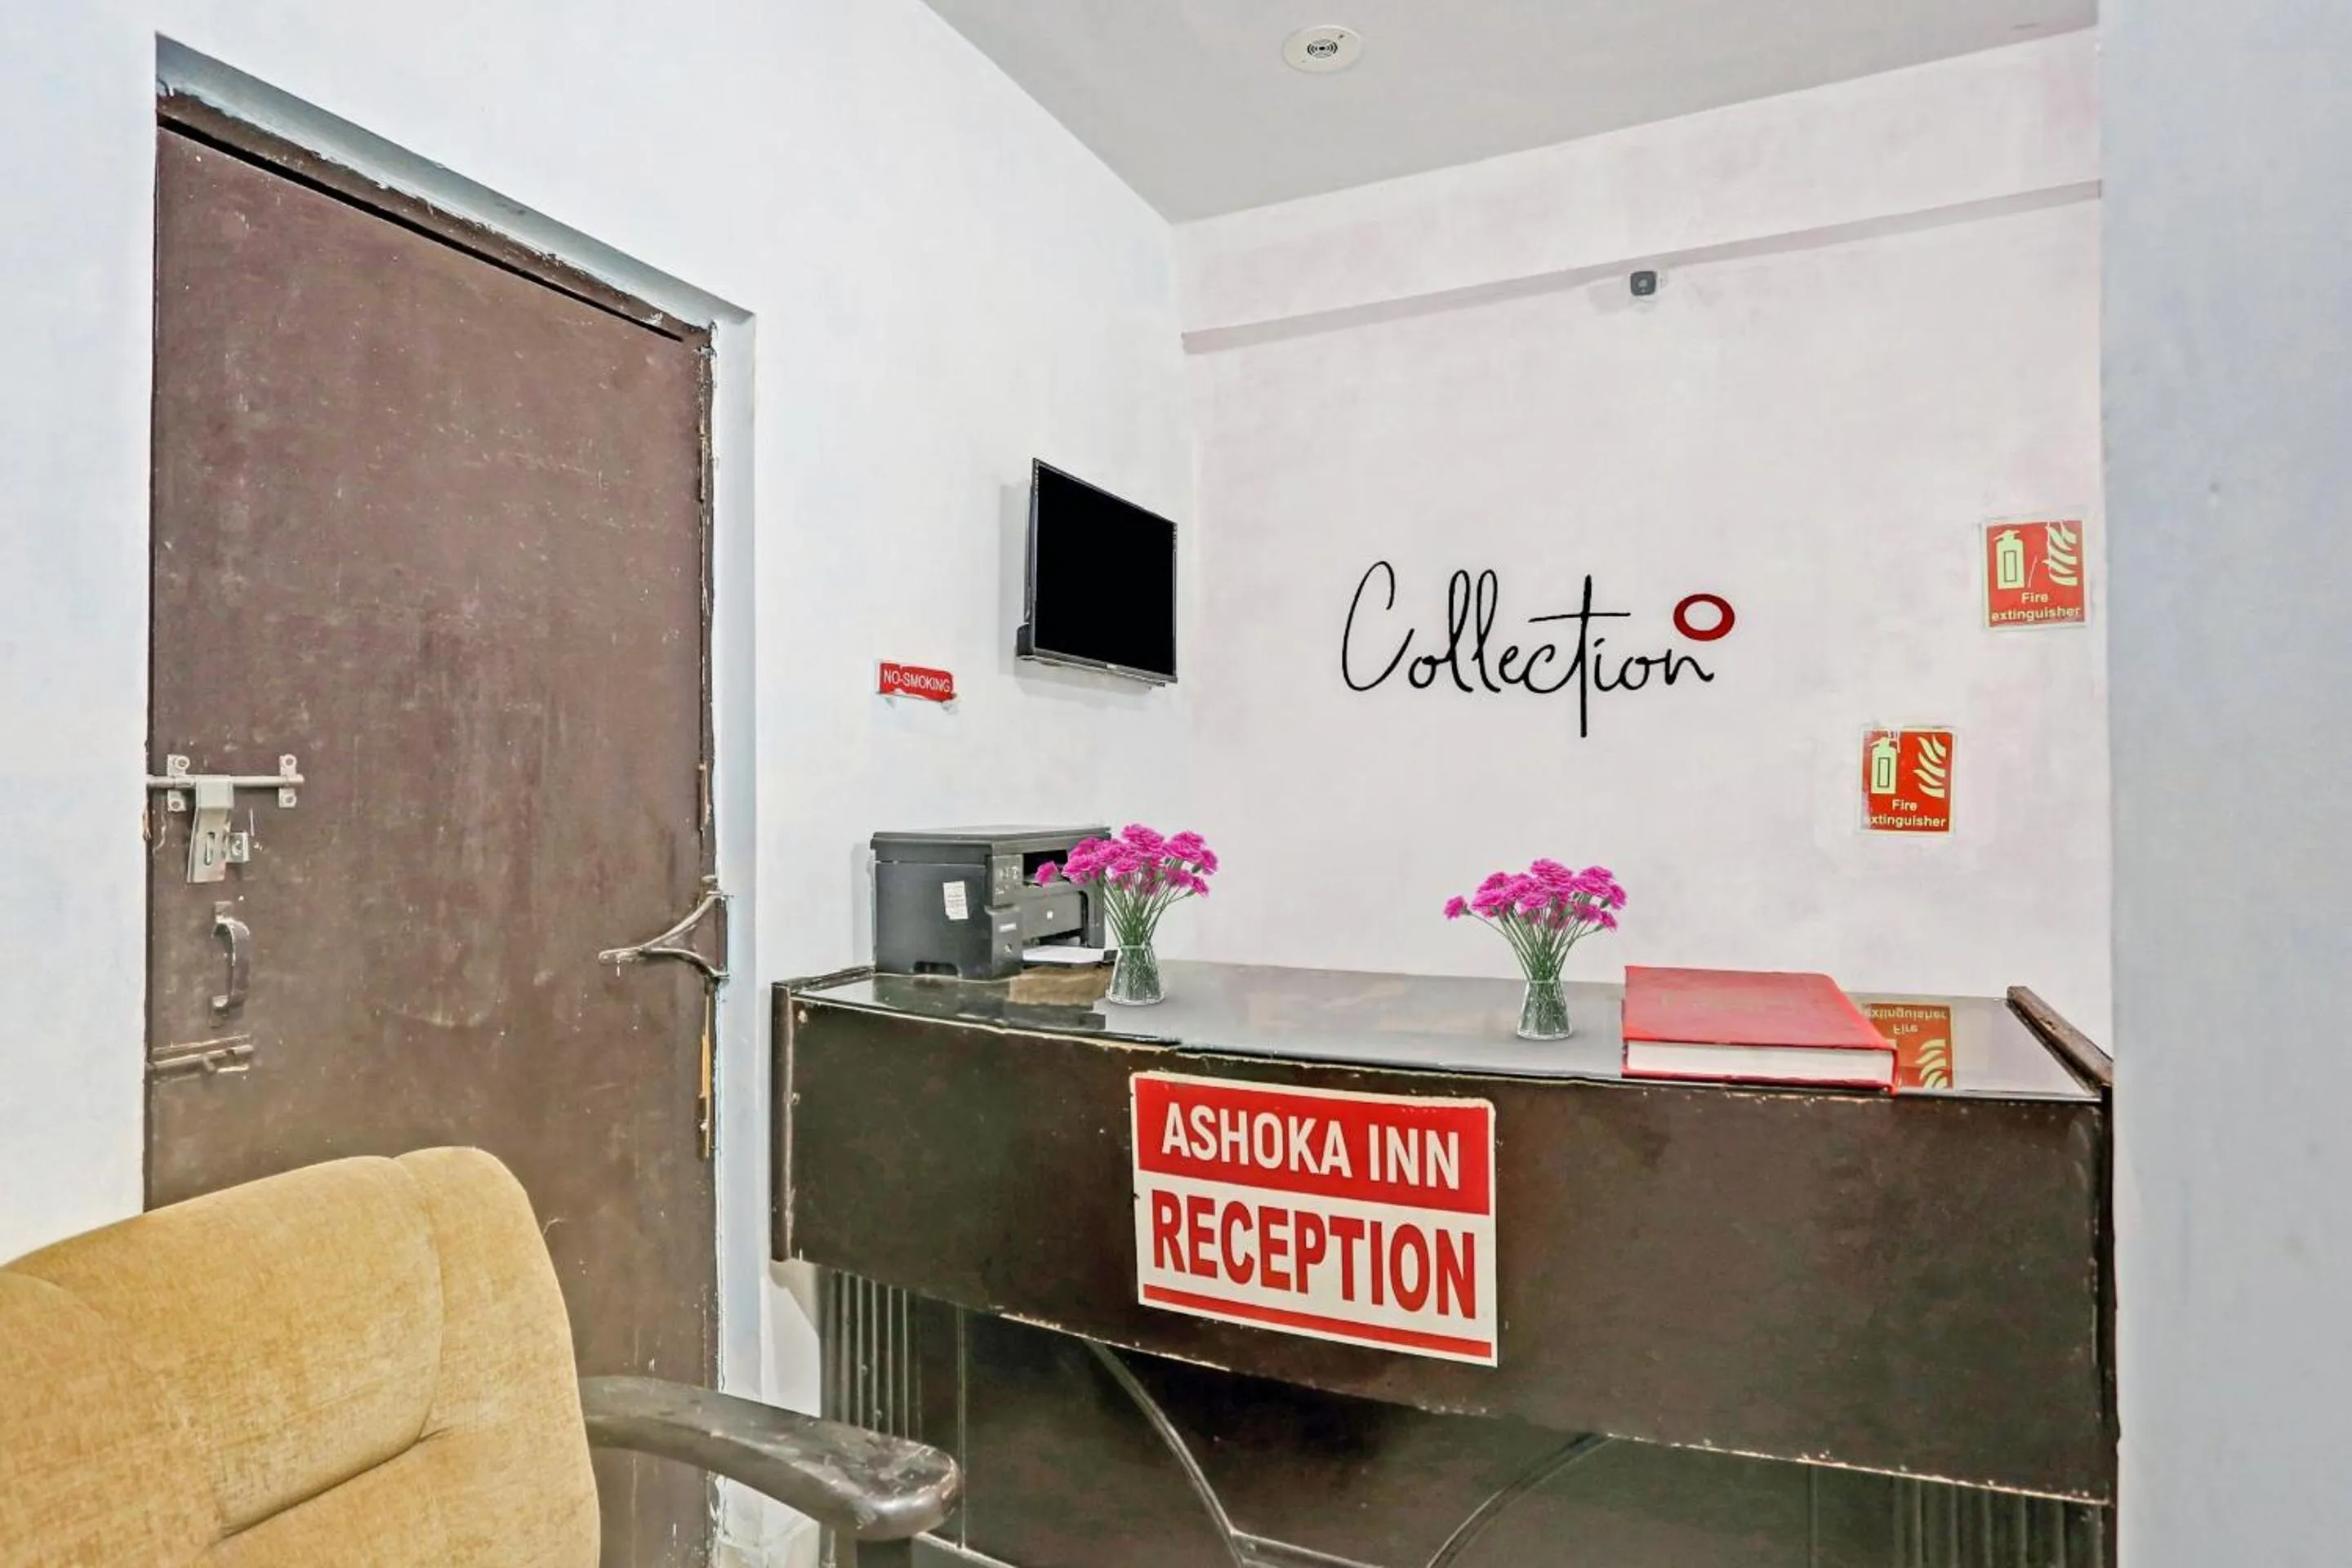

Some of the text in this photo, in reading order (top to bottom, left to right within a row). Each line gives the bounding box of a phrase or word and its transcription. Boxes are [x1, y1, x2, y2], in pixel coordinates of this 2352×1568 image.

[2021, 592, 2048, 604] Fire
[1991, 605, 2081, 621] extinguisher
[1342, 560, 1715, 738] Collection
[1891, 799, 1918, 811] Fire
[1869, 814, 1947, 828] xtinguisher
[1161, 1102, 1459, 1190] ASHOKA INN
[1152, 1189, 1477, 1320] RECEPTION
